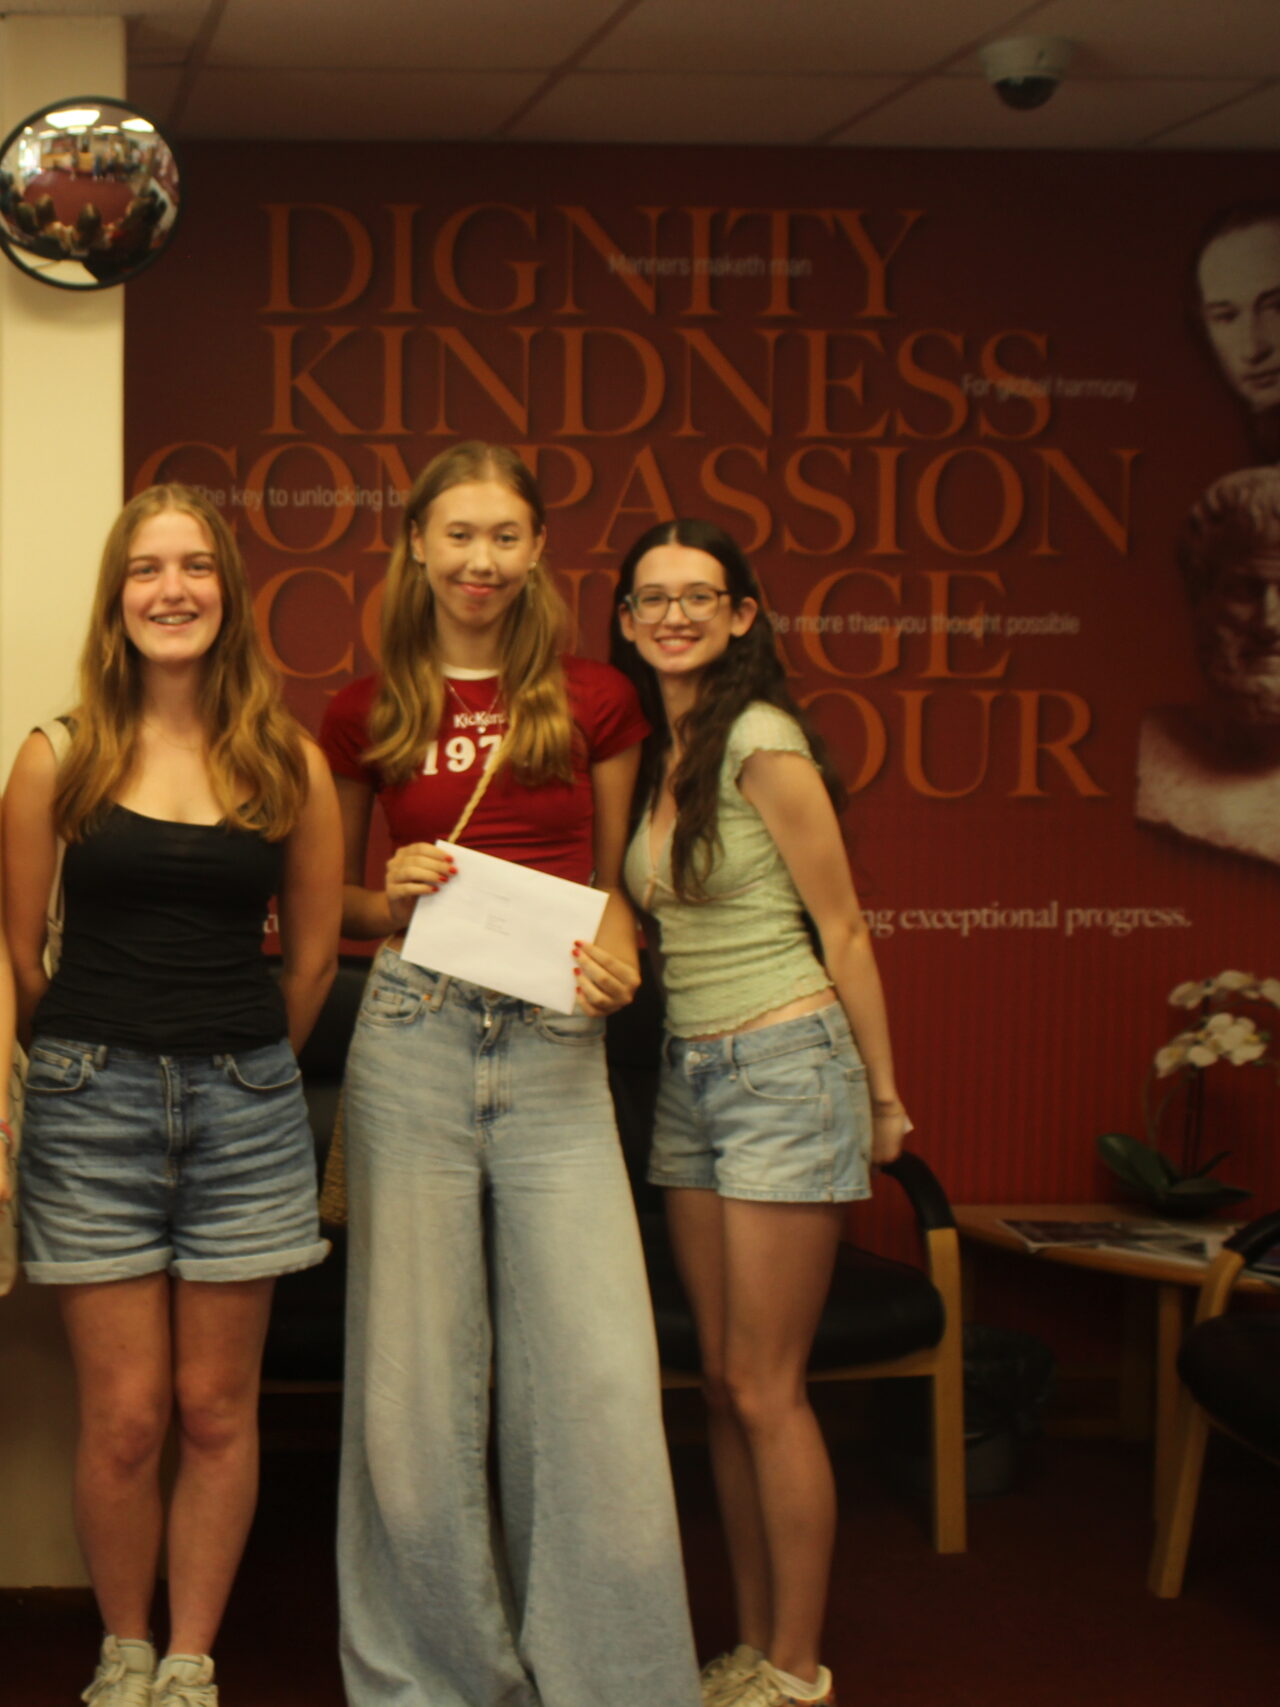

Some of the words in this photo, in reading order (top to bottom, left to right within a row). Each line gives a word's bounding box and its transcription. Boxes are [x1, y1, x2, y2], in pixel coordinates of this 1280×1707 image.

[257, 202, 928, 319] DIGNITY
[259, 324, 1052, 441] KINDNESS
[423, 734, 503, 776] 197
[899, 901, 1059, 938] exceptional
[1064, 905, 1193, 938] progress.
